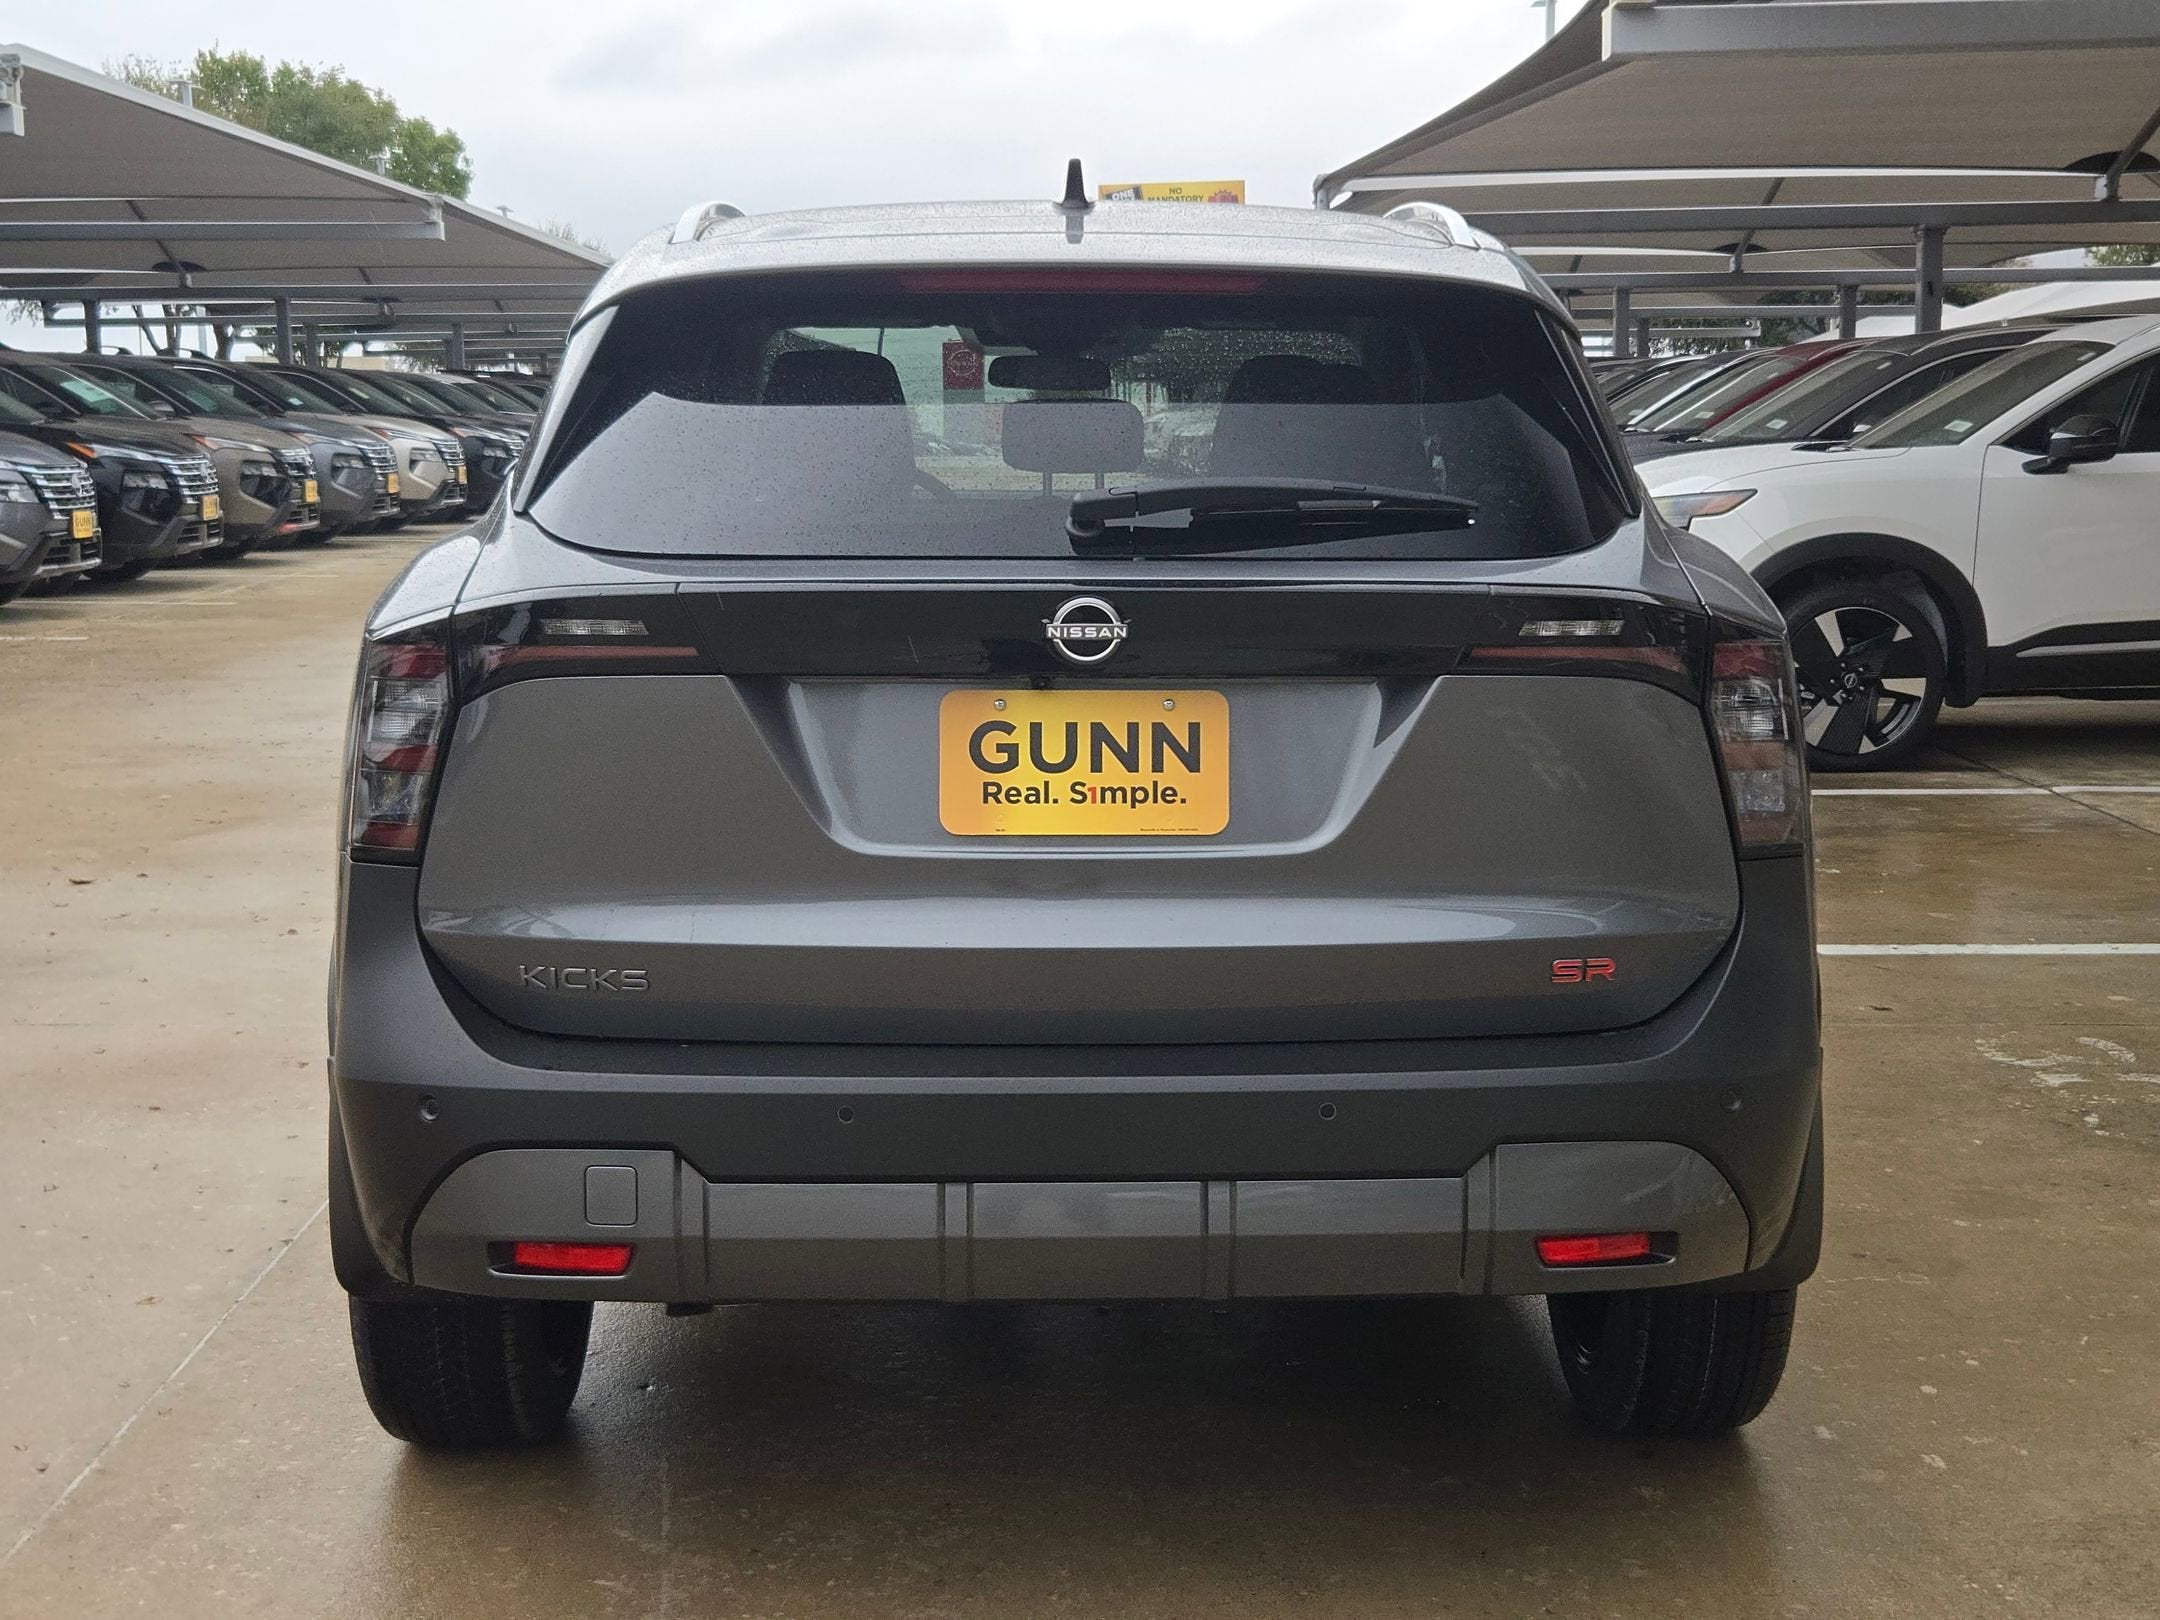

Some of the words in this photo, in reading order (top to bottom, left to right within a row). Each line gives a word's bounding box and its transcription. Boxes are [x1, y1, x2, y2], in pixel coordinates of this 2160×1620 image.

[1168, 187, 1183, 195] NO
[1047, 626, 1127, 638] NISSAN
[968, 719, 1201, 774] GUNN
[982, 780, 1059, 804] Real.
[519, 964, 650, 991] KICKS
[1551, 957, 1616, 982] SR
